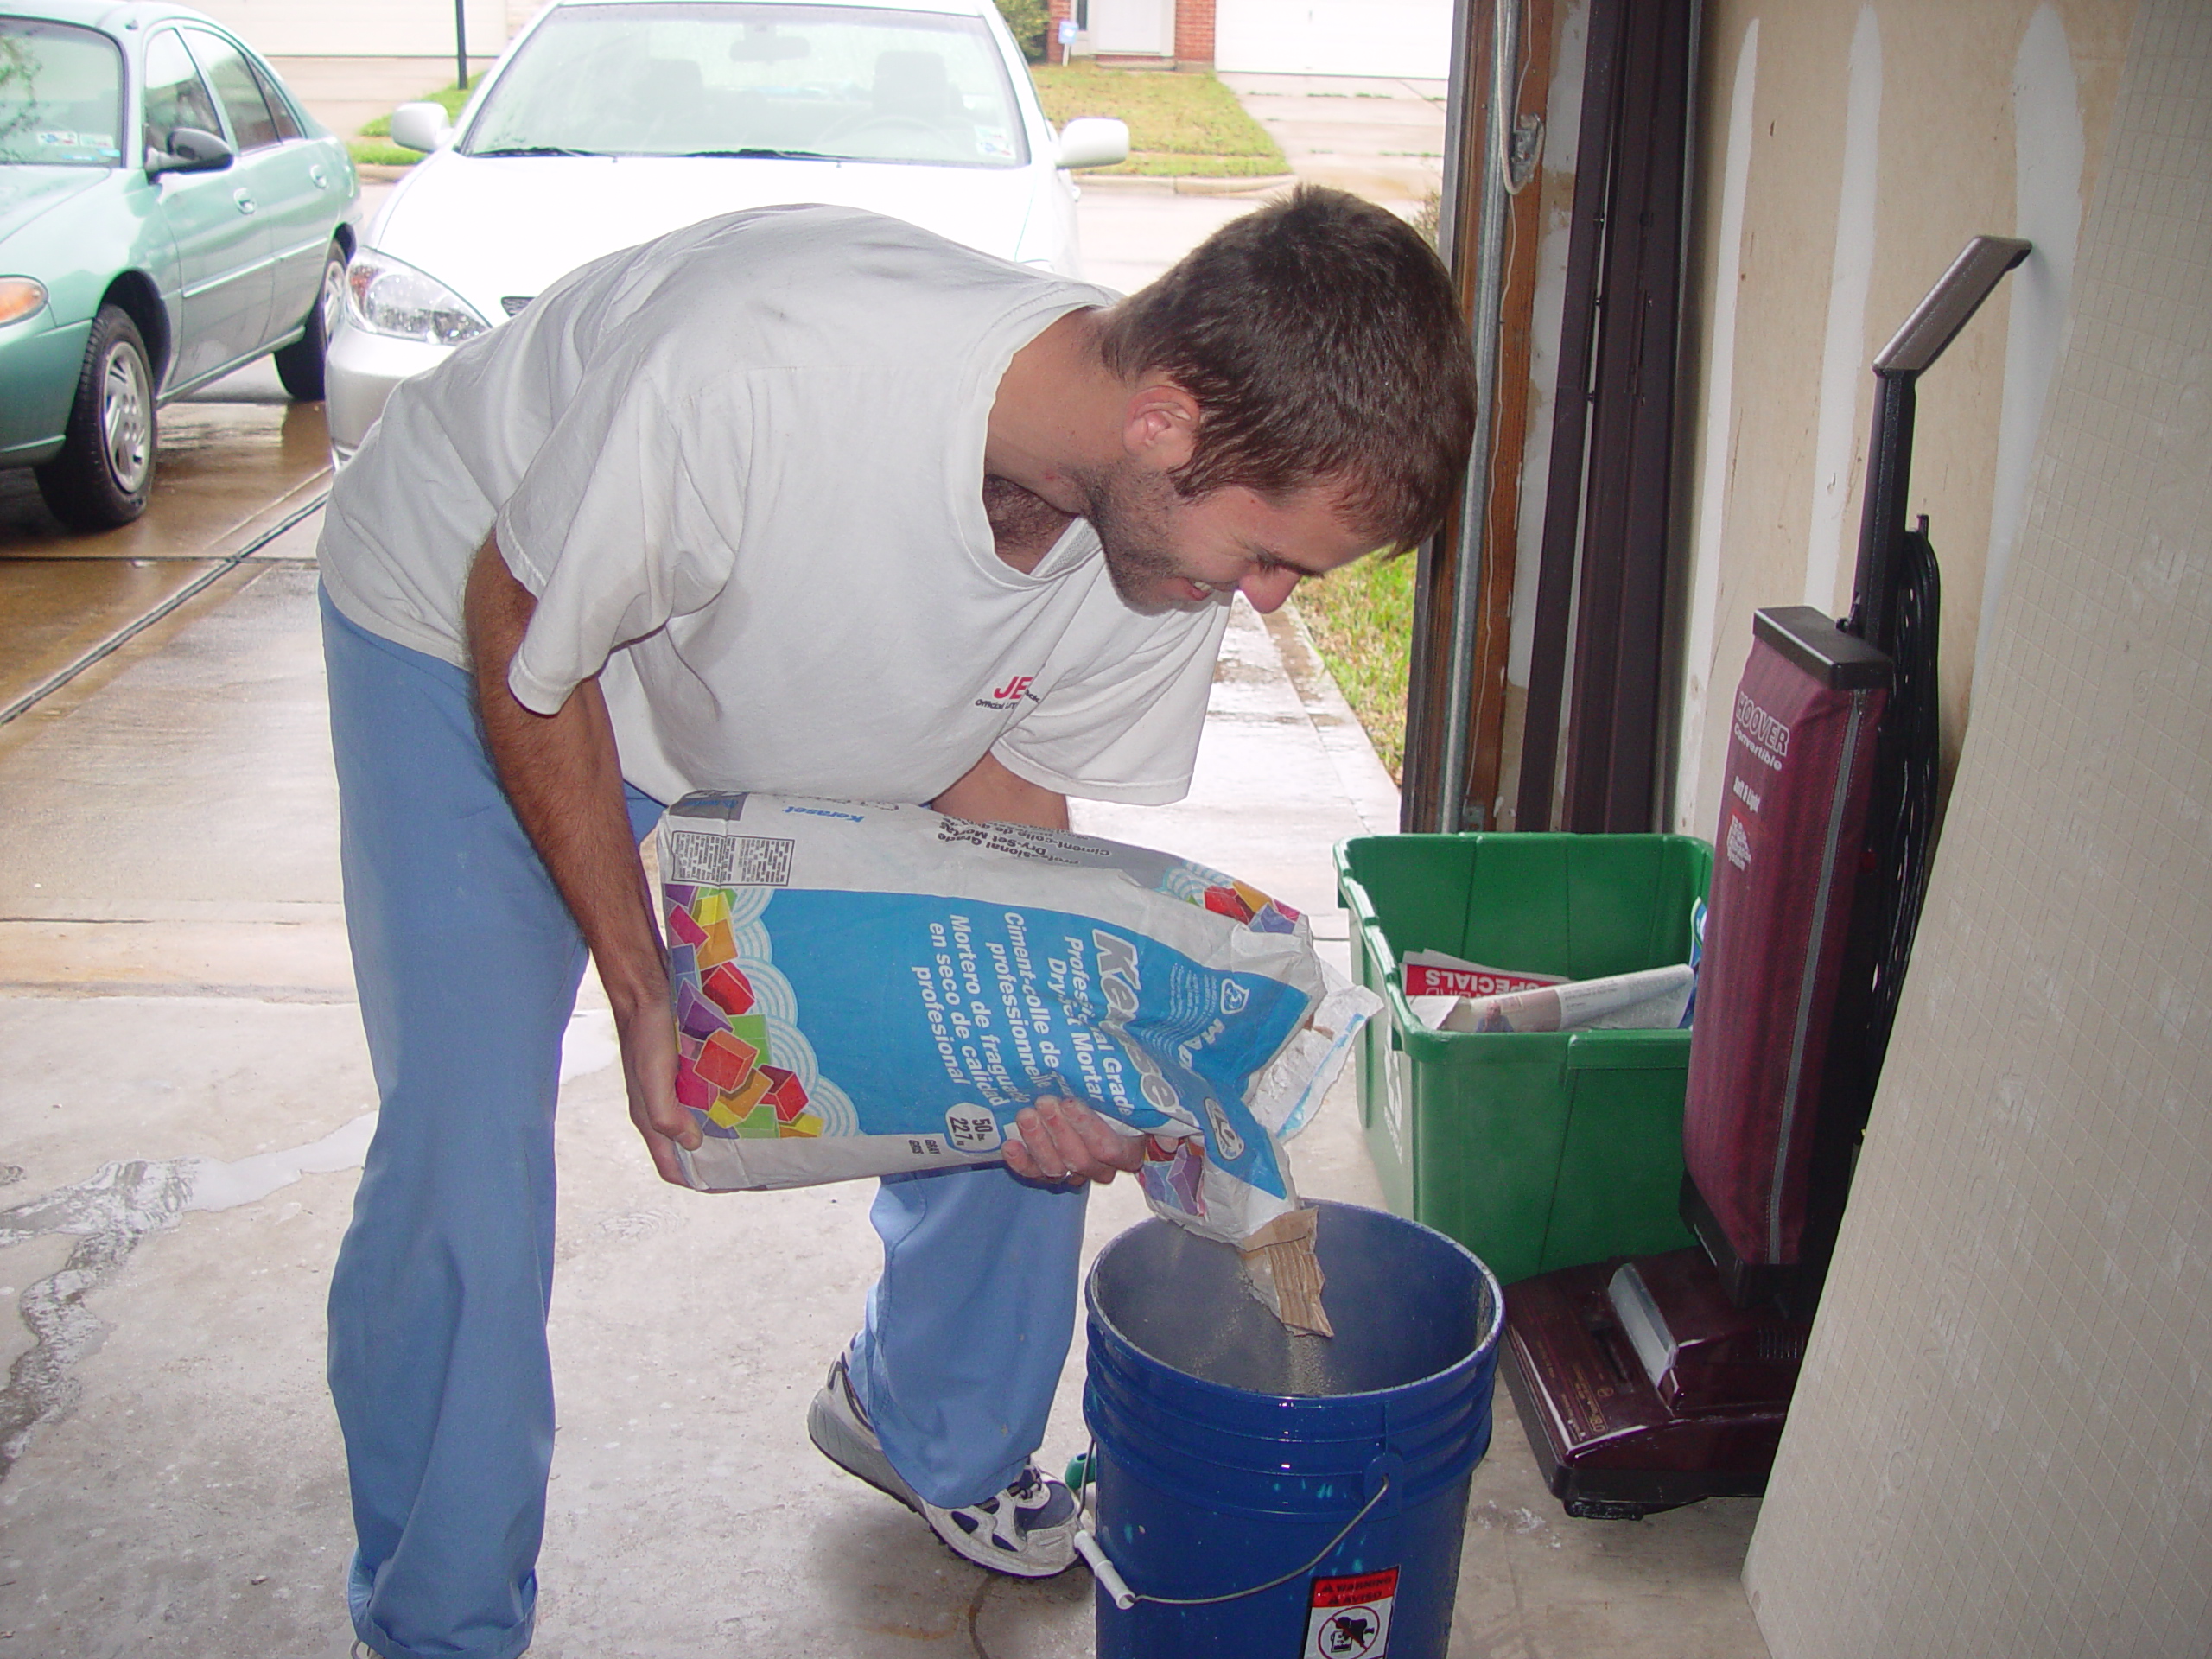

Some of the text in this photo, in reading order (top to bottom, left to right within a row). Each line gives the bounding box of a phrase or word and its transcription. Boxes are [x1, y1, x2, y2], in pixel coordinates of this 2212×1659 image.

[1736, 691, 1791, 758] HOOVER
[992, 836, 1047, 855] Dry-Set
[911, 966, 972, 1085] profesional
[929, 922, 1010, 1106] en seco de calidad
[950, 914, 1031, 1103] Mortero de fraguado
[985, 942, 1052, 1088] professionnelle
[1004, 912, 1052, 1034] Ciment-colle
[1039, 1040, 1062, 1069] de
[1064, 936, 1135, 1116] Profesioal Grade
[971, 1118, 994, 1132] 50
[1071, 1033, 1105, 1103] Mortar
[1335, 1576, 1393, 1593] WARNING
